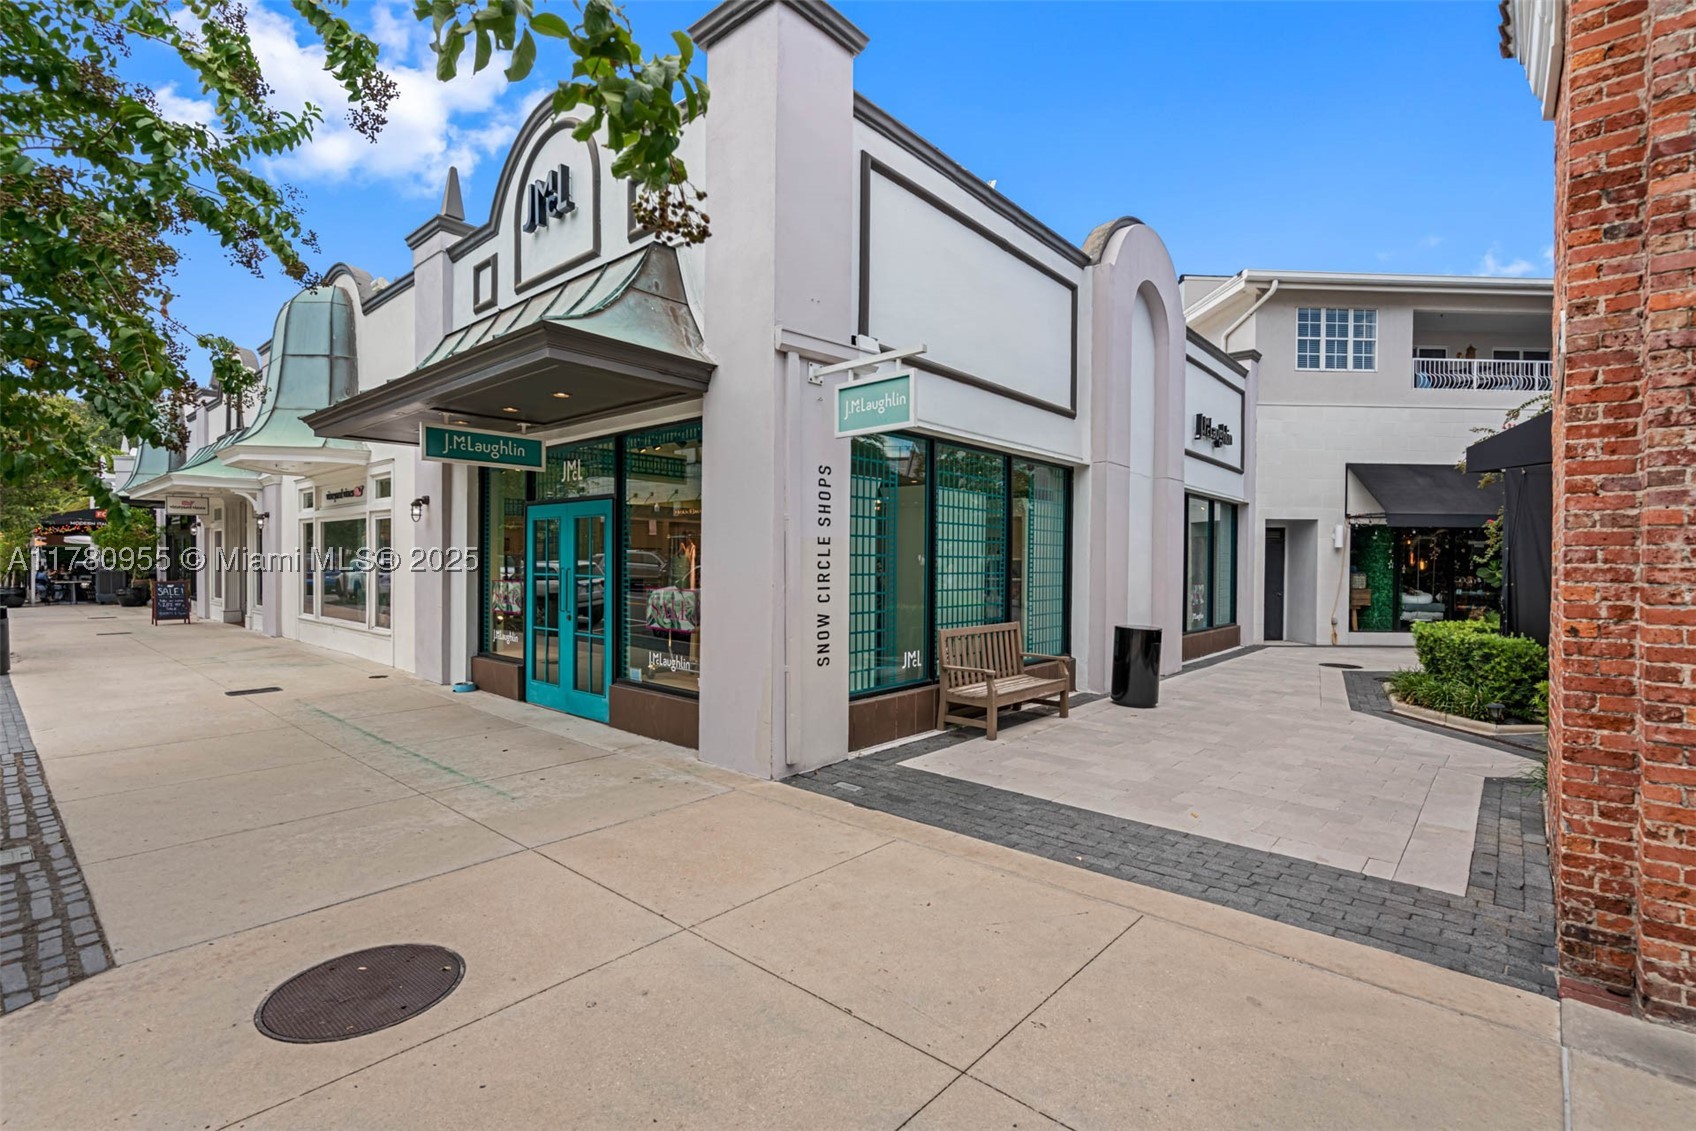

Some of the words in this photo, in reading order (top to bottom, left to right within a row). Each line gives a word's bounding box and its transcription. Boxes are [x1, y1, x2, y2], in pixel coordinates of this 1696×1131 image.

[442, 432, 526, 459] J.McLaughlin
[818, 465, 832, 527] SHOPS
[817, 536, 831, 603] CIRCLE
[816, 613, 831, 667] SNOW
